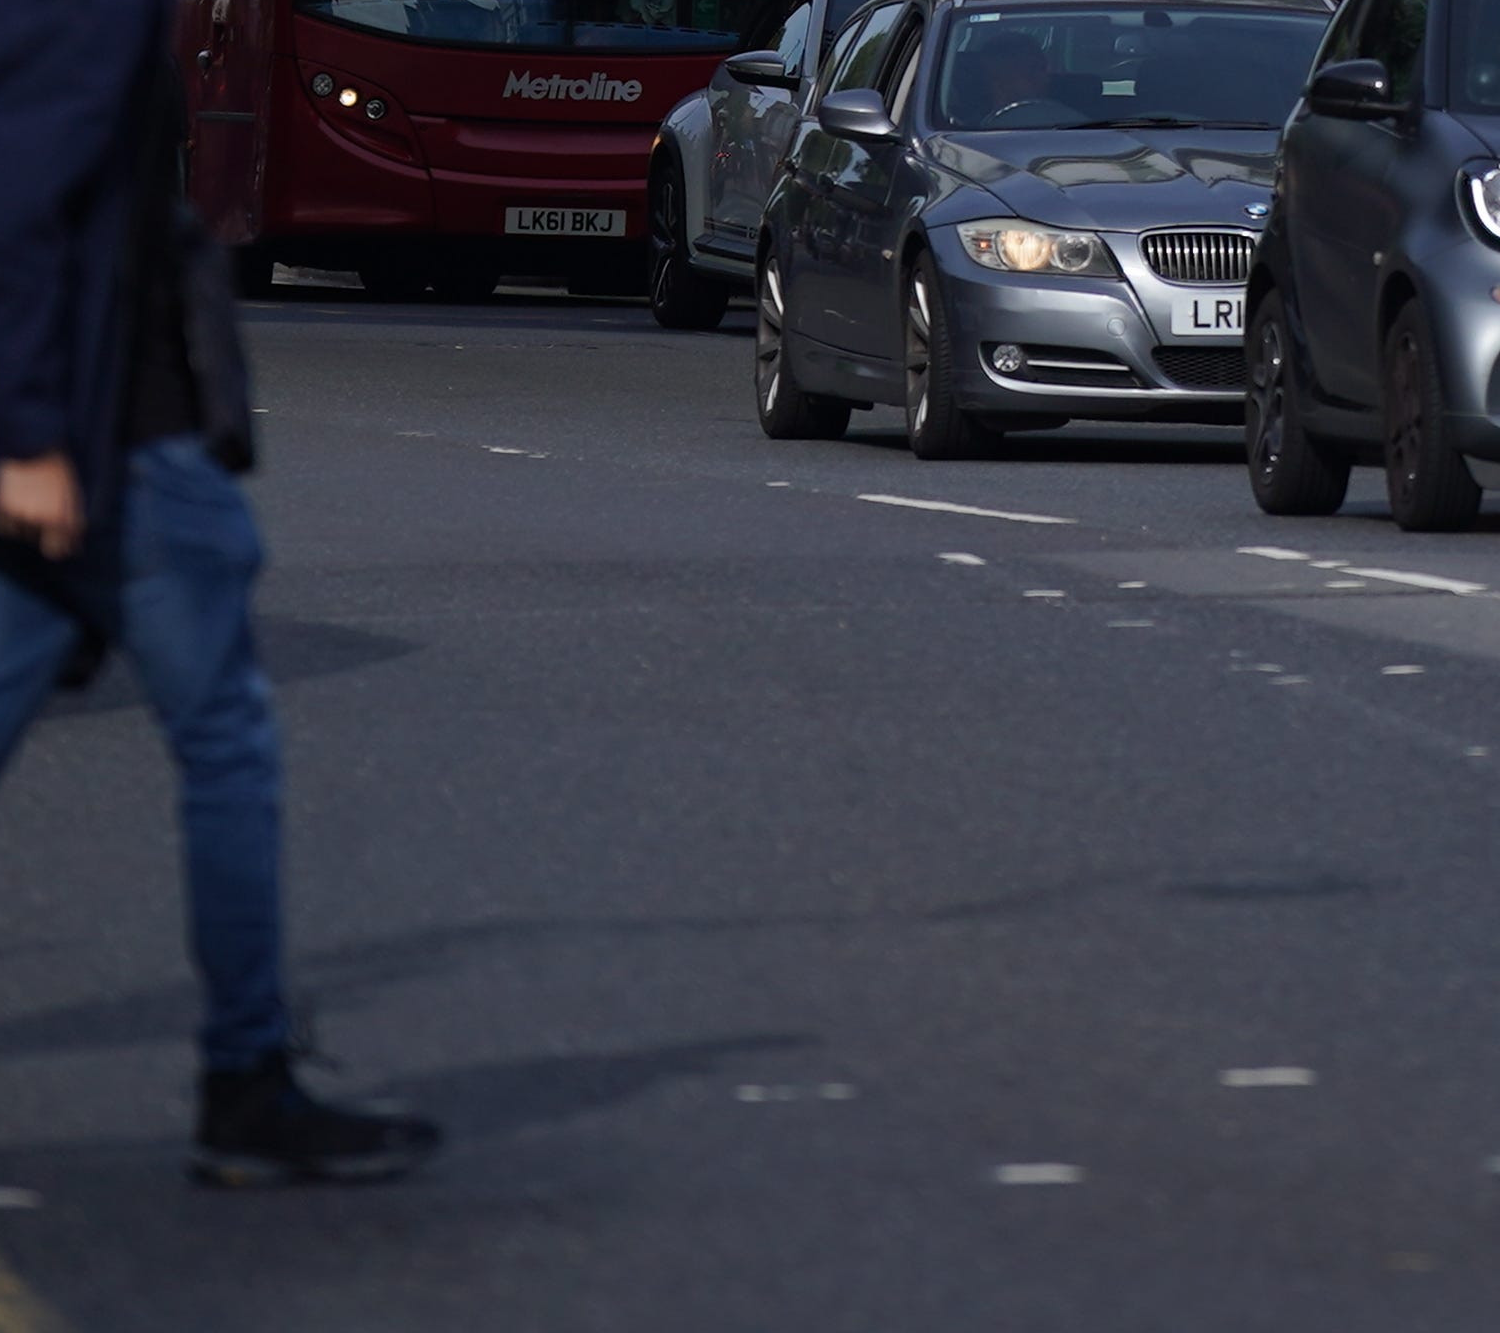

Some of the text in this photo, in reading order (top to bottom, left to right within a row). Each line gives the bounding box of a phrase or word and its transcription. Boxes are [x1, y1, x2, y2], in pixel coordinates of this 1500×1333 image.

[502, 69, 643, 103] Metroline
[518, 210, 613, 232] LK61 BKJ
